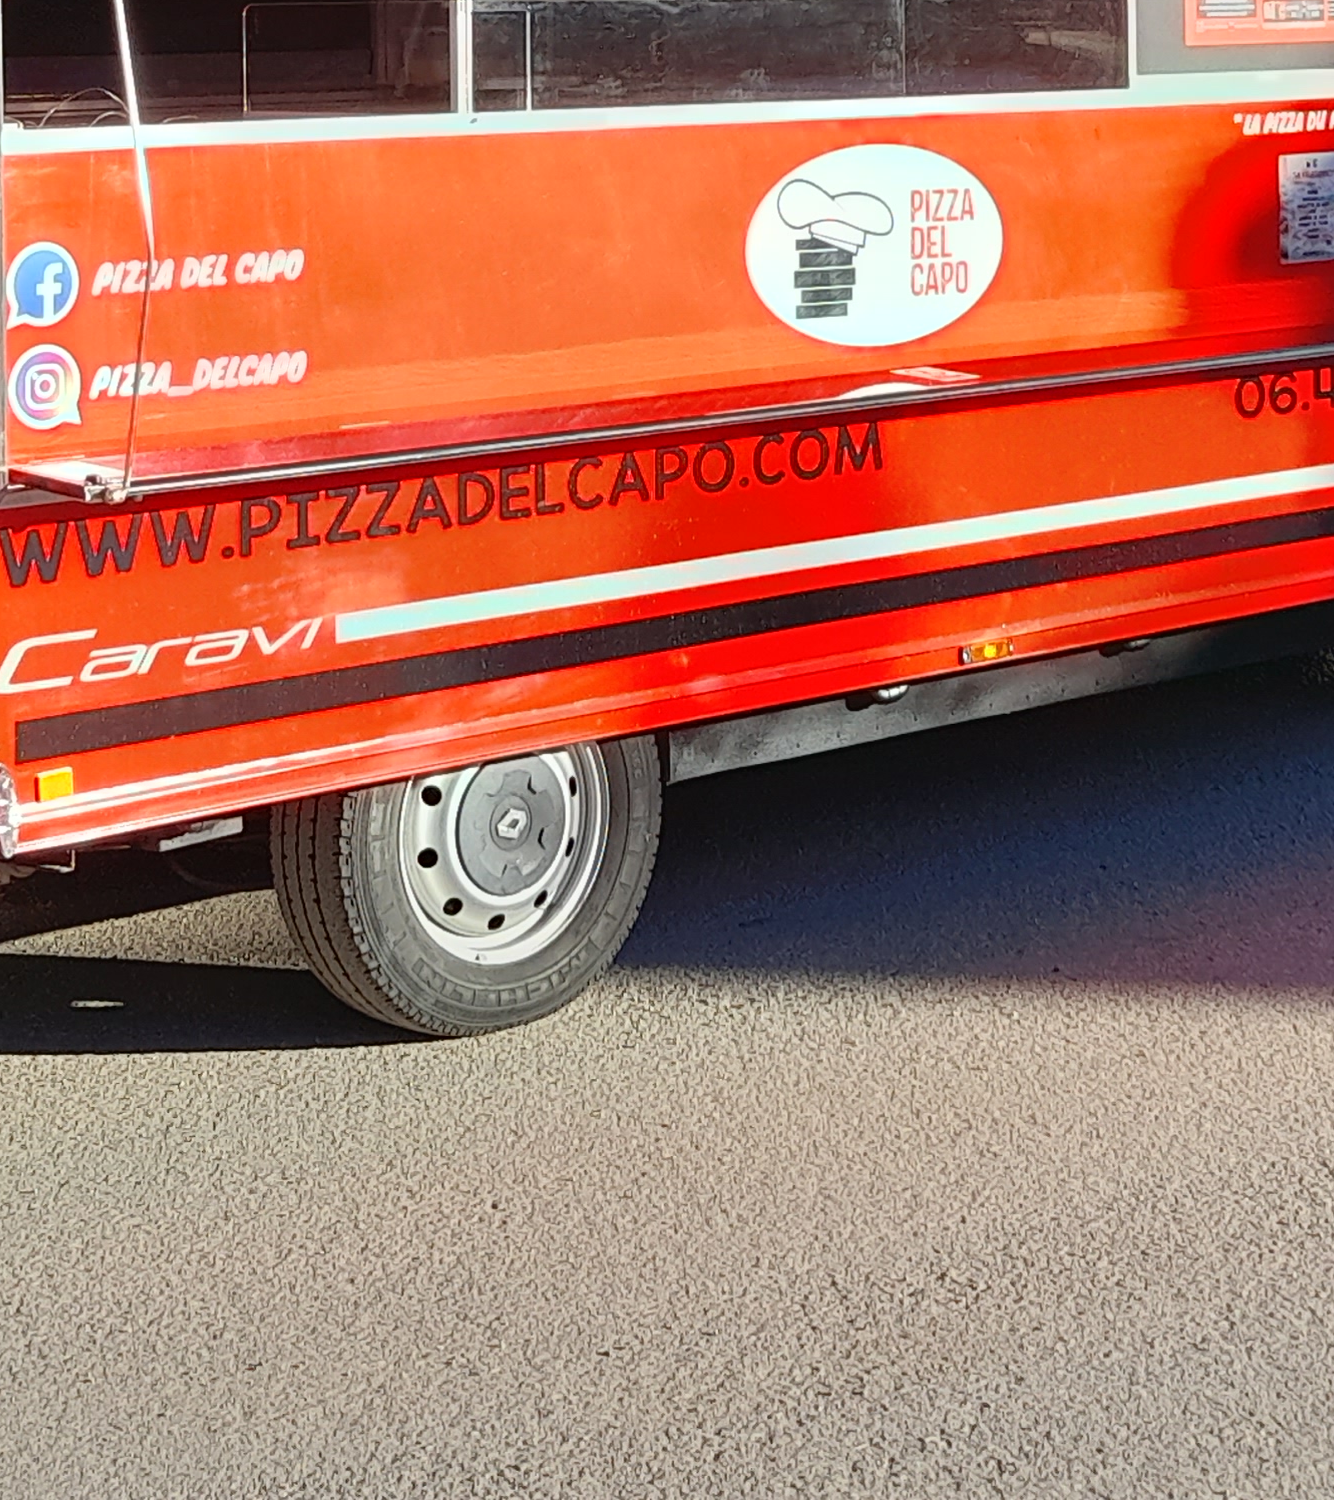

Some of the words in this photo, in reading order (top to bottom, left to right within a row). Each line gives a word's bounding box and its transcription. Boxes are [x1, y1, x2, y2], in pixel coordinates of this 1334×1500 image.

[910, 188, 975, 222] PIZZA
[910, 225, 953, 260] DEL
[91, 254, 174, 297] PIZZA
[180, 253, 228, 288] DEL
[233, 248, 305, 283] CAPO
[910, 260, 969, 296] CAPO
[89, 351, 308, 401] PIZZA_DELCAPO
